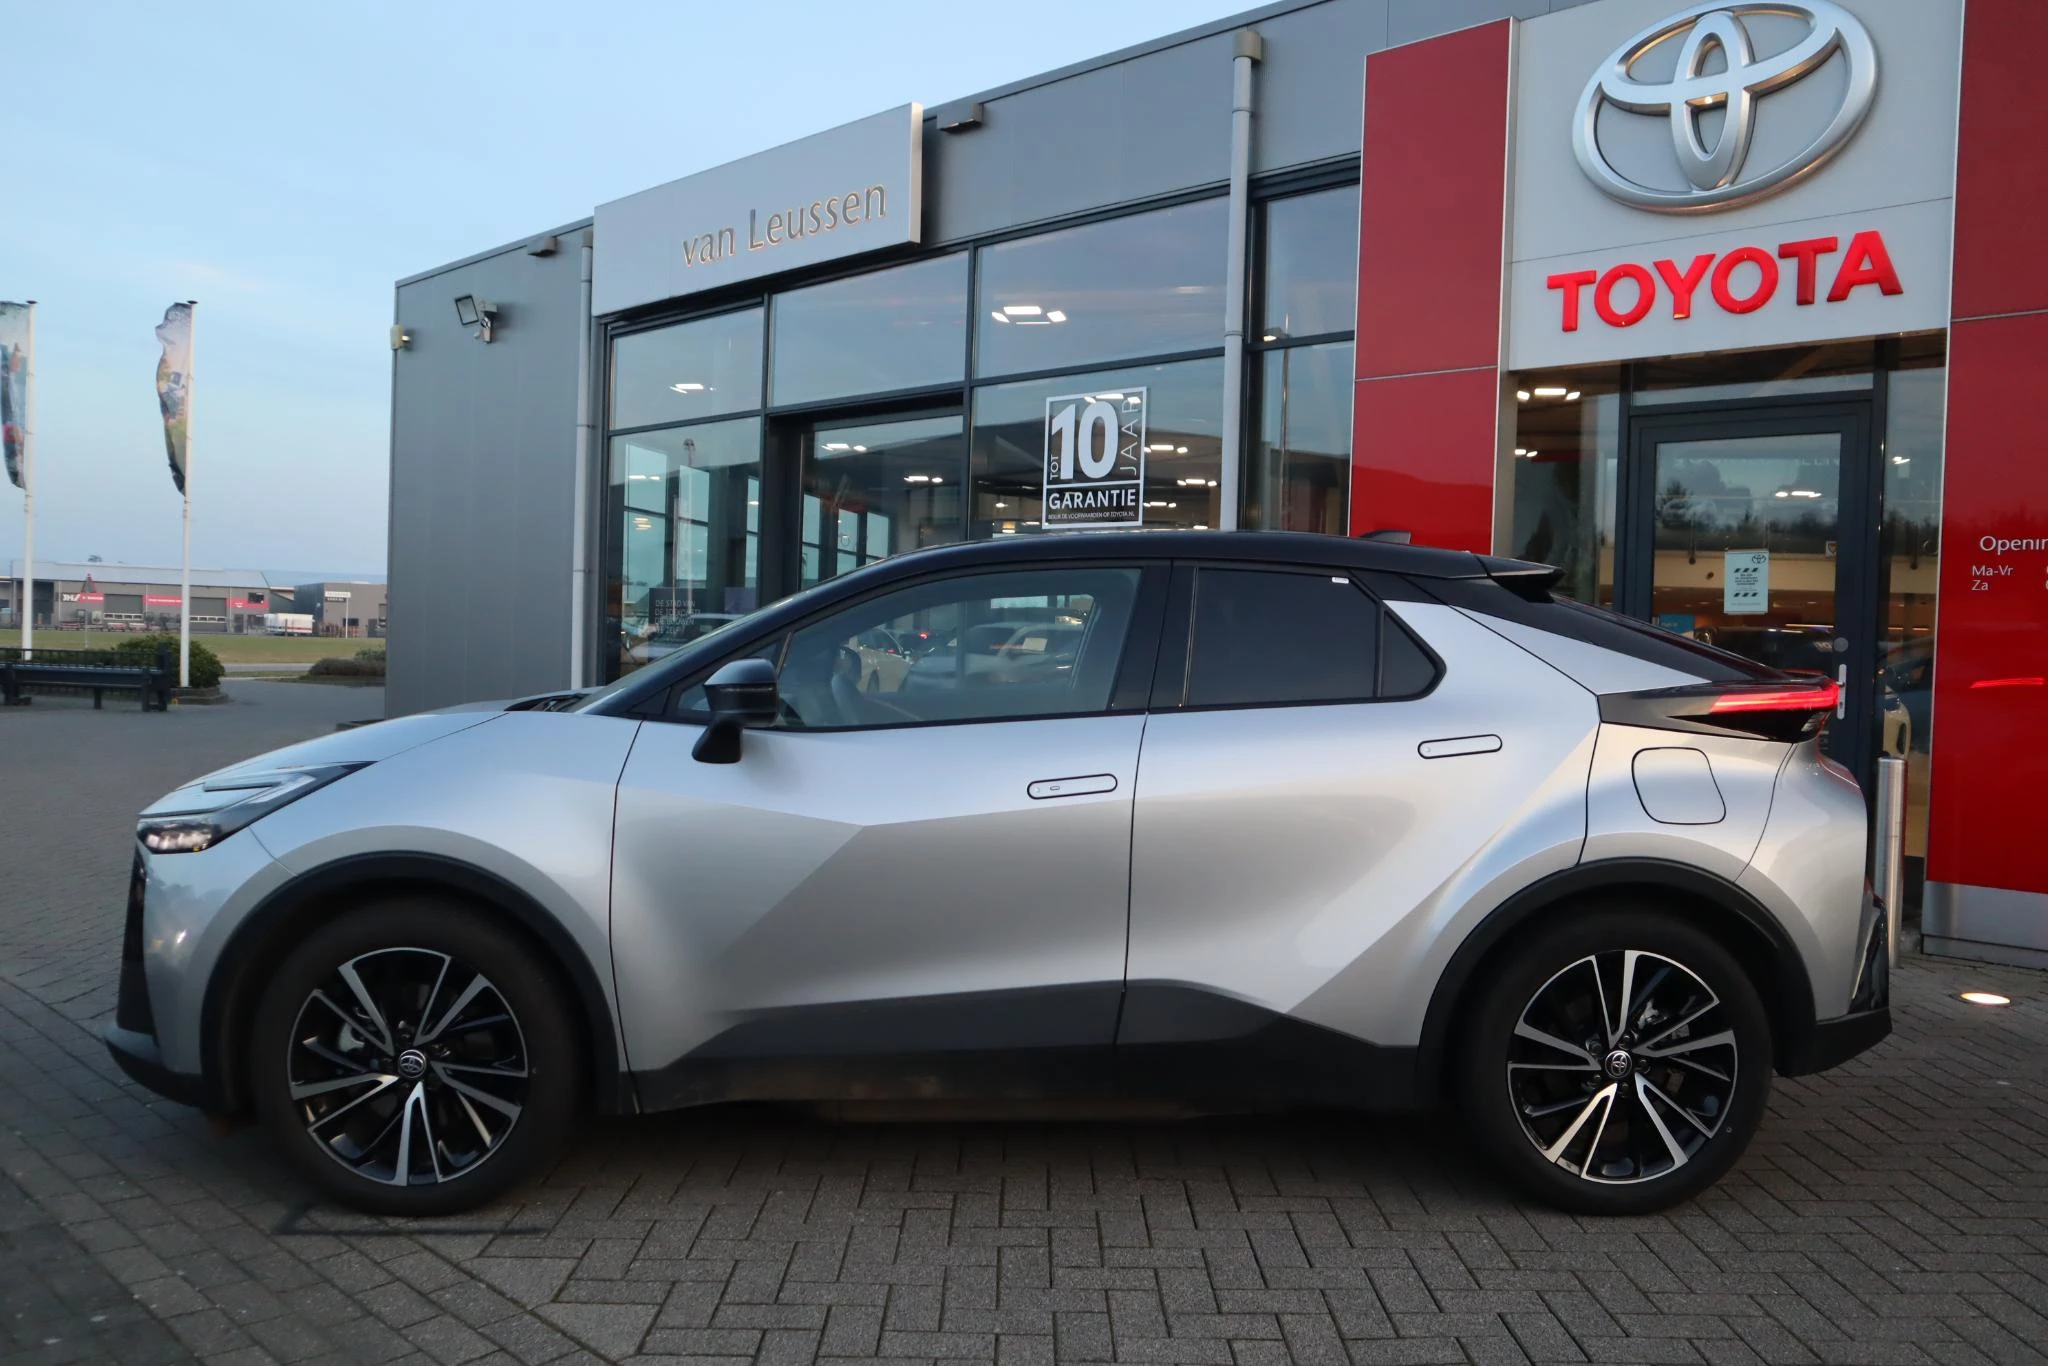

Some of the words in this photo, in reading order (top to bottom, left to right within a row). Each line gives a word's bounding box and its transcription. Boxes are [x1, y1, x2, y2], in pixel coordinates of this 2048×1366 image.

[682, 226, 735, 268] van
[748, 182, 886, 252] Leussen
[1546, 229, 1904, 332] TOYOTA
[1051, 400, 1119, 480] 10
[1119, 397, 1141, 476] JAAR
[1050, 455, 1059, 480] TOT
[1048, 488, 1137, 510] GARANTIE
[1971, 579, 1989, 591] Za
[1972, 564, 2014, 577] Ma-Vr
